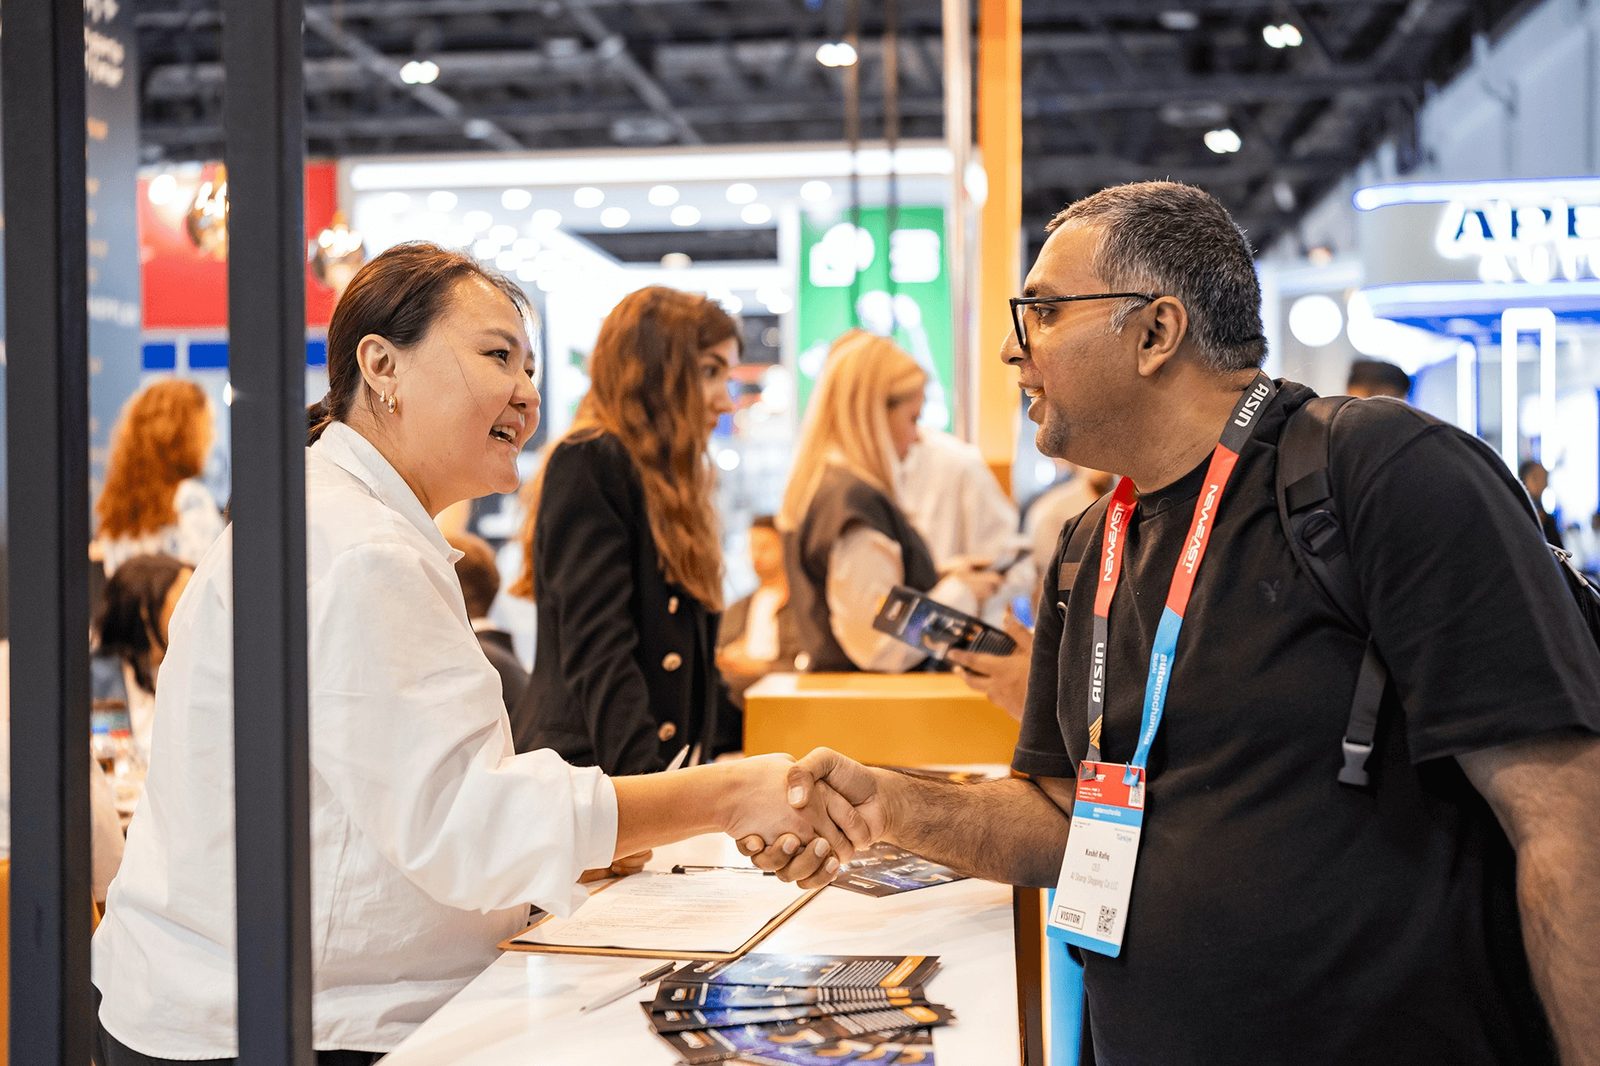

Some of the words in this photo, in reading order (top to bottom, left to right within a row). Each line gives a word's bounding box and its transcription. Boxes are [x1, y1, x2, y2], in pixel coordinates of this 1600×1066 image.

[1233, 382, 1270, 428] AISIN
[1103, 502, 1125, 582] NEWEAST
[1186, 484, 1219, 574] NEWEAST
[1092, 642, 1105, 703] AISIN
[1143, 653, 1168, 745] automechanika
[1060, 910, 1081, 925] VISITOR
